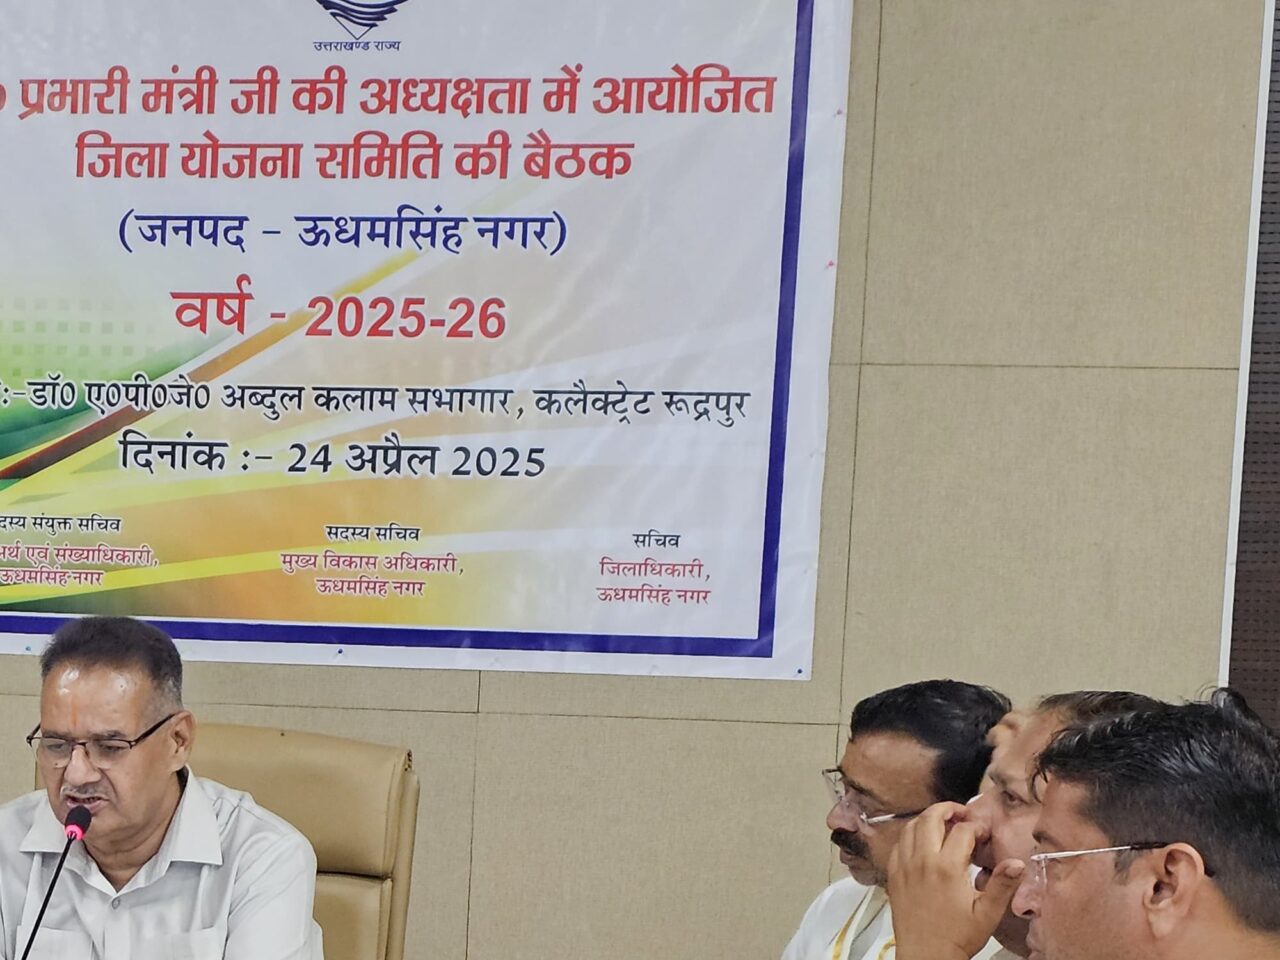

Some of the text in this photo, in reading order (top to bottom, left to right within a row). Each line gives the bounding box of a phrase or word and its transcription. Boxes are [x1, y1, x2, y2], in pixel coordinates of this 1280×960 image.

[373, 41, 401, 51] राज्य
[17, 65, 130, 120] प्रभारी
[141, 65, 218, 115] मंत्री
[230, 65, 280, 115] जी
[291, 65, 347, 115] की
[360, 77, 530, 118] अध्यक्षता
[543, 63, 583, 114] में
[592, 63, 777, 114] आयोजित
[76, 128, 635, 179] जिला योजना समिति की बैठक
[119, 208, 250, 253] (जनपद
[294, 204, 468, 254] ऊधमसिंह
[473, 210, 567, 256] नगर)
[169, 273, 255, 335] वर्ष
[305, 296, 507, 338] 2025-26
[221, 384, 305, 420] अब्दुल
[312, 385, 398, 413] कलाम
[532, 380, 655, 424] कलैक्ट्रेट
[662, 391, 751, 427] रूद्रपुर
[118, 428, 229, 474] दिनांक
[287, 443, 332, 473] 24
[345, 432, 440, 476] अप्रैल
[452, 446, 546, 477] 2025
[31, 512, 72, 536] संयुक्त
[77, 513, 121, 532] सचिव
[326, 522, 421, 541] सदस्य सचिव
[632, 529, 681, 548] सचिव
[25, 542, 50, 565] एवं
[281, 553, 318, 574] मुख्य
[323, 550, 378, 569] विकास
[72, 571, 104, 586] नगर
[316, 575, 426, 596] ऊधमसिंह नगर
[596, 583, 712, 606] ऊधमसिंह नगर
